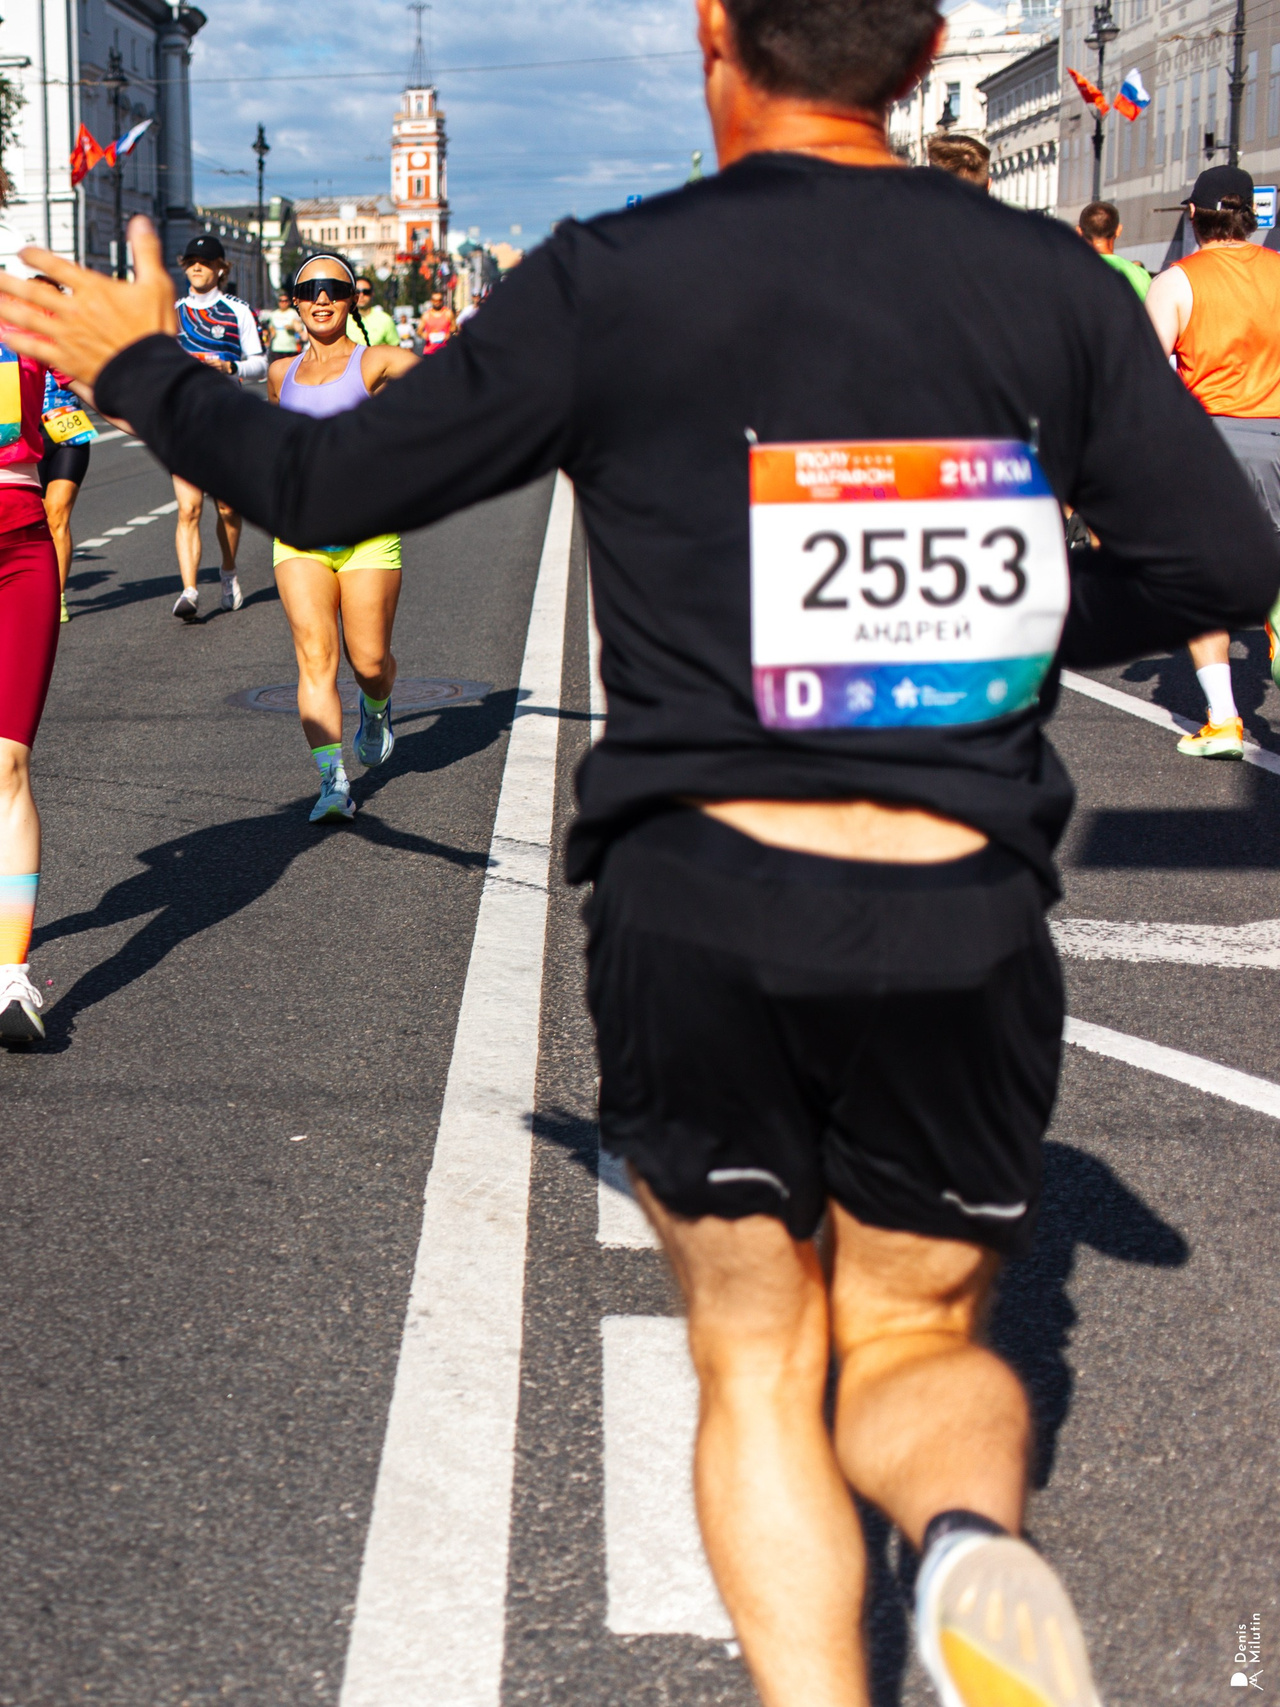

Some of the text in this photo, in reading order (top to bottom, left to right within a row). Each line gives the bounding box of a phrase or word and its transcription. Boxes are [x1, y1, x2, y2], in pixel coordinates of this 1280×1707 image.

[57, 415, 82, 433] 368
[940, 458, 1032, 486] 21,1 КМ
[801, 526, 1029, 610] 2553
[855, 615, 972, 645] АНДРЕЙ
[784, 669, 822, 719] D
